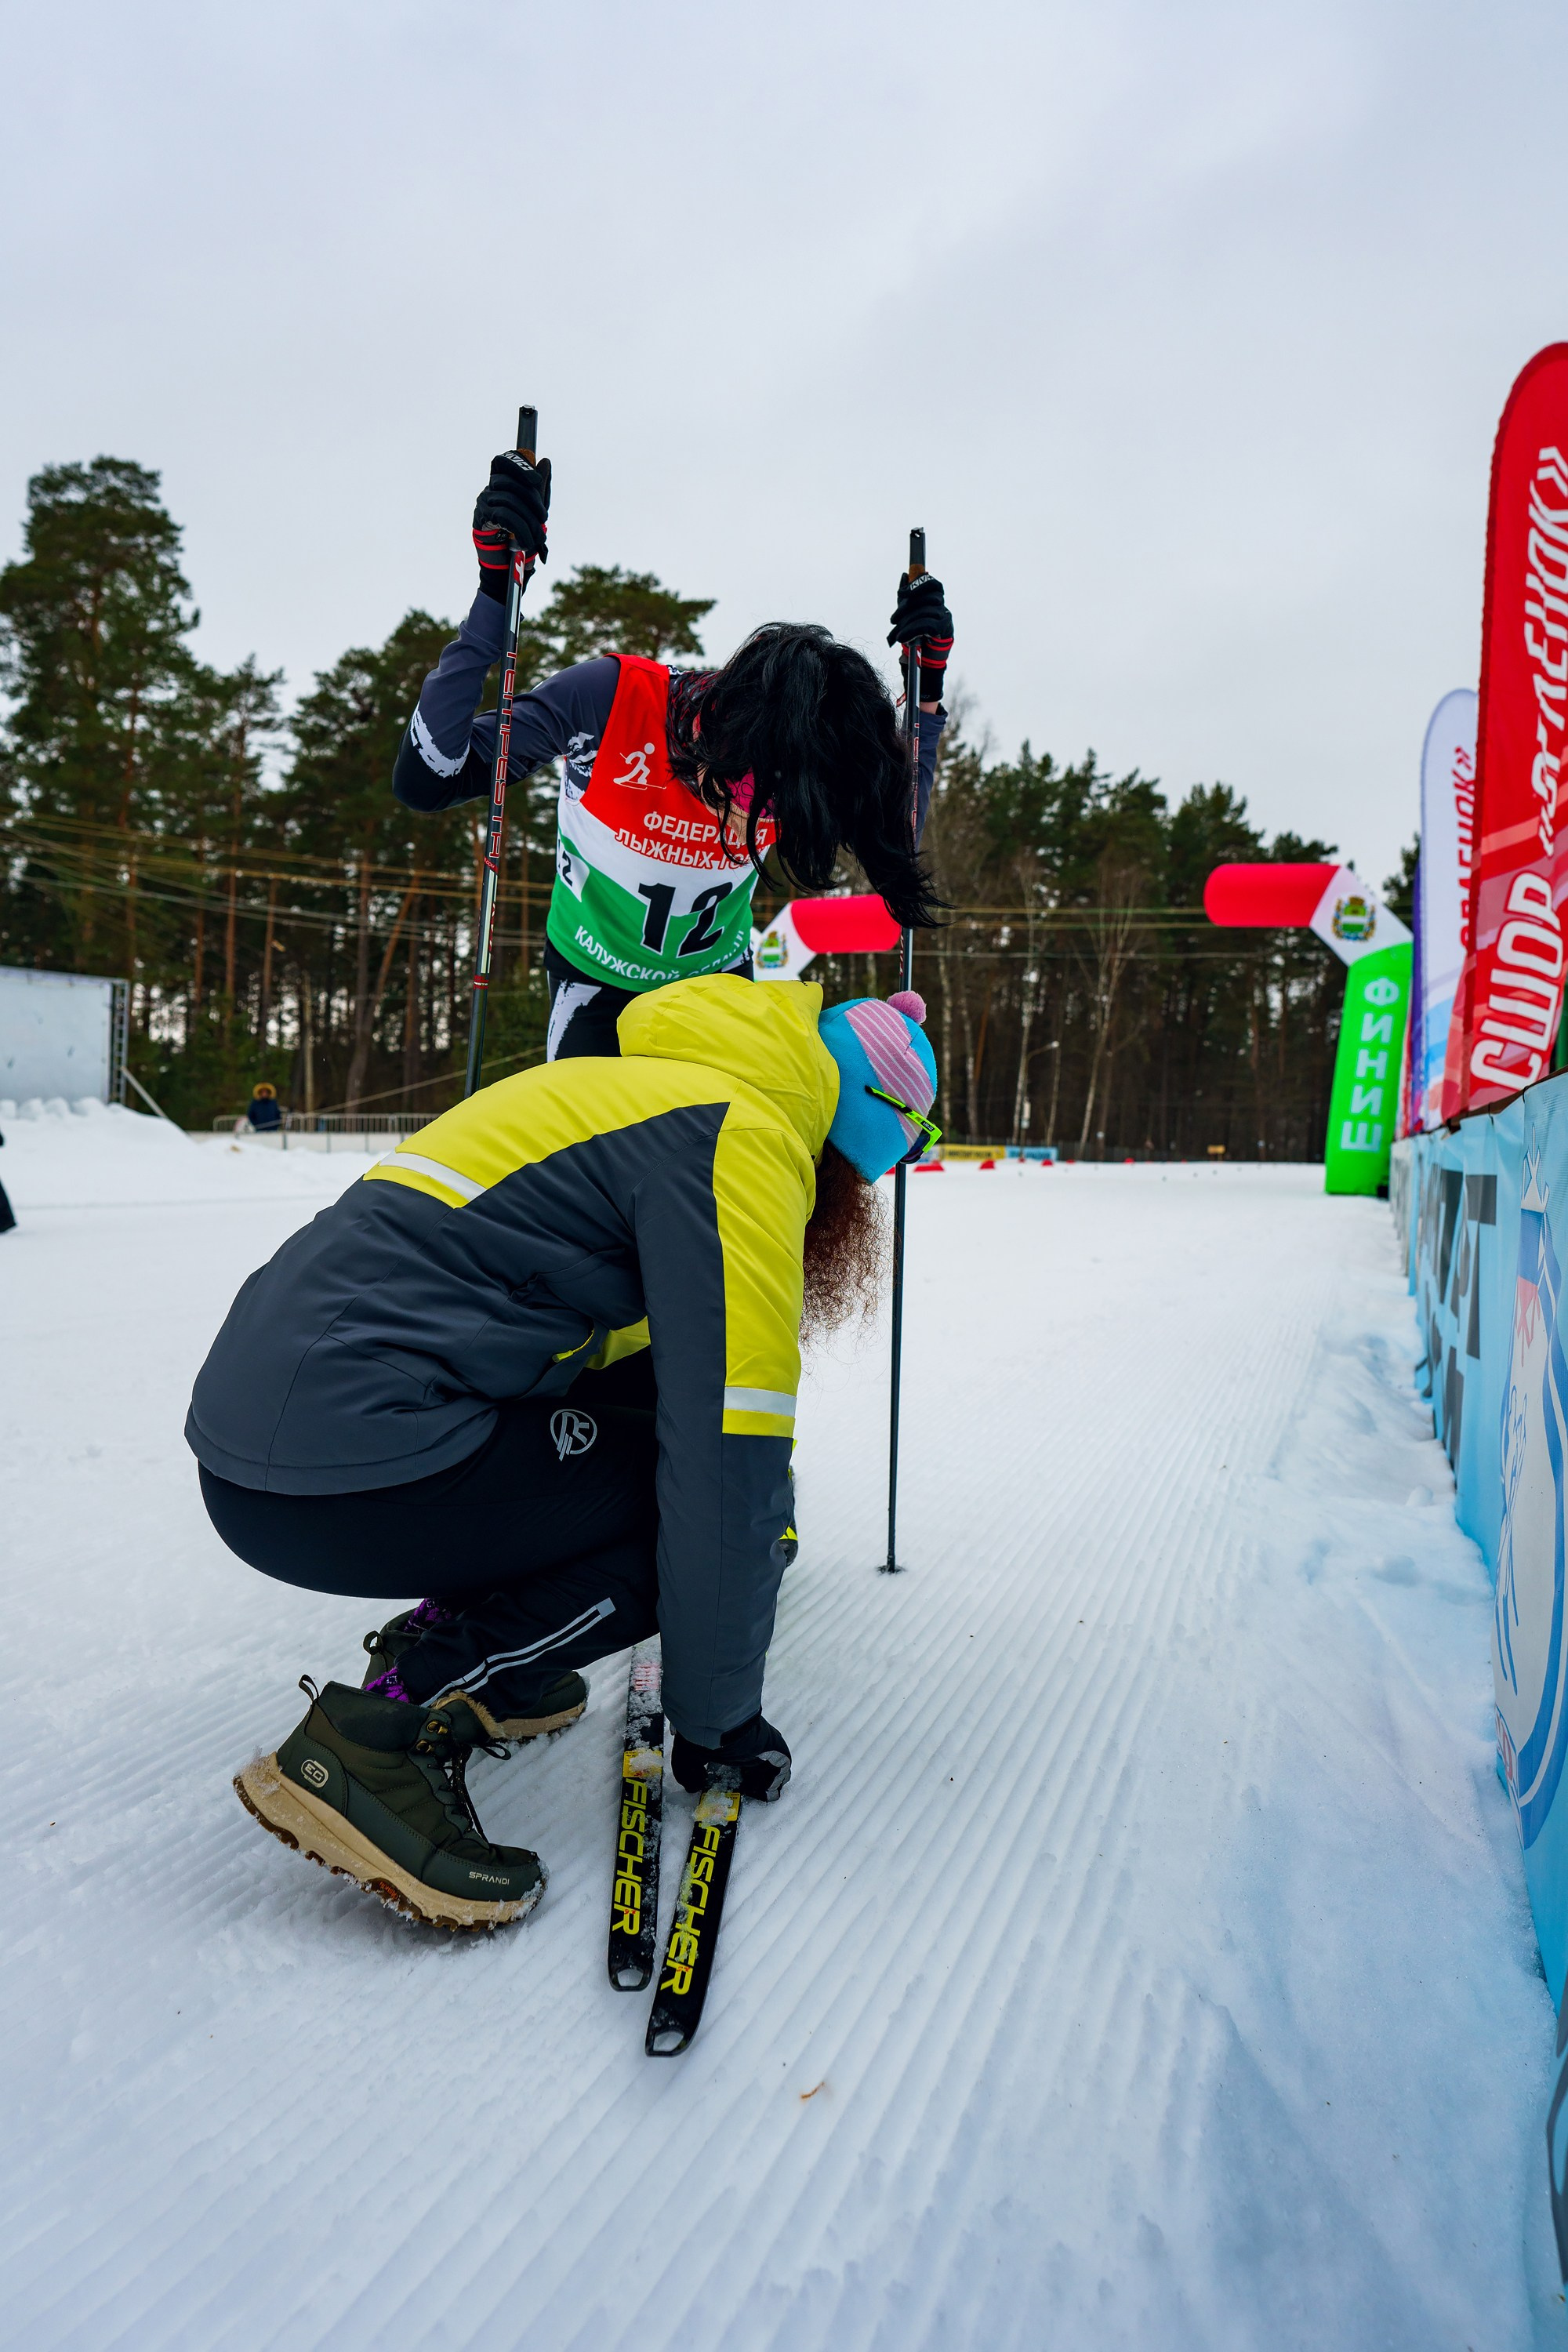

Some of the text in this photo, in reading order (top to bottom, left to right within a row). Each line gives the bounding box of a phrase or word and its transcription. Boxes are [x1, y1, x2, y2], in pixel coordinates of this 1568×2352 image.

[615, 827, 715, 869] ЛЫЖНЫХ
[643, 811, 768, 849] ФЕДЕРАЦЯ
[574, 925, 681, 981] КАЛУЖСКОЙ
[637, 881, 734, 959] 12
[1469, 872, 1563, 1084] СШОР
[1340, 977, 1400, 1152] ФИНИШ
[468, 1871, 510, 1886] SPRANDI
[612, 1777, 648, 1936] FISCHER
[660, 1822, 721, 1995] FISCHER
